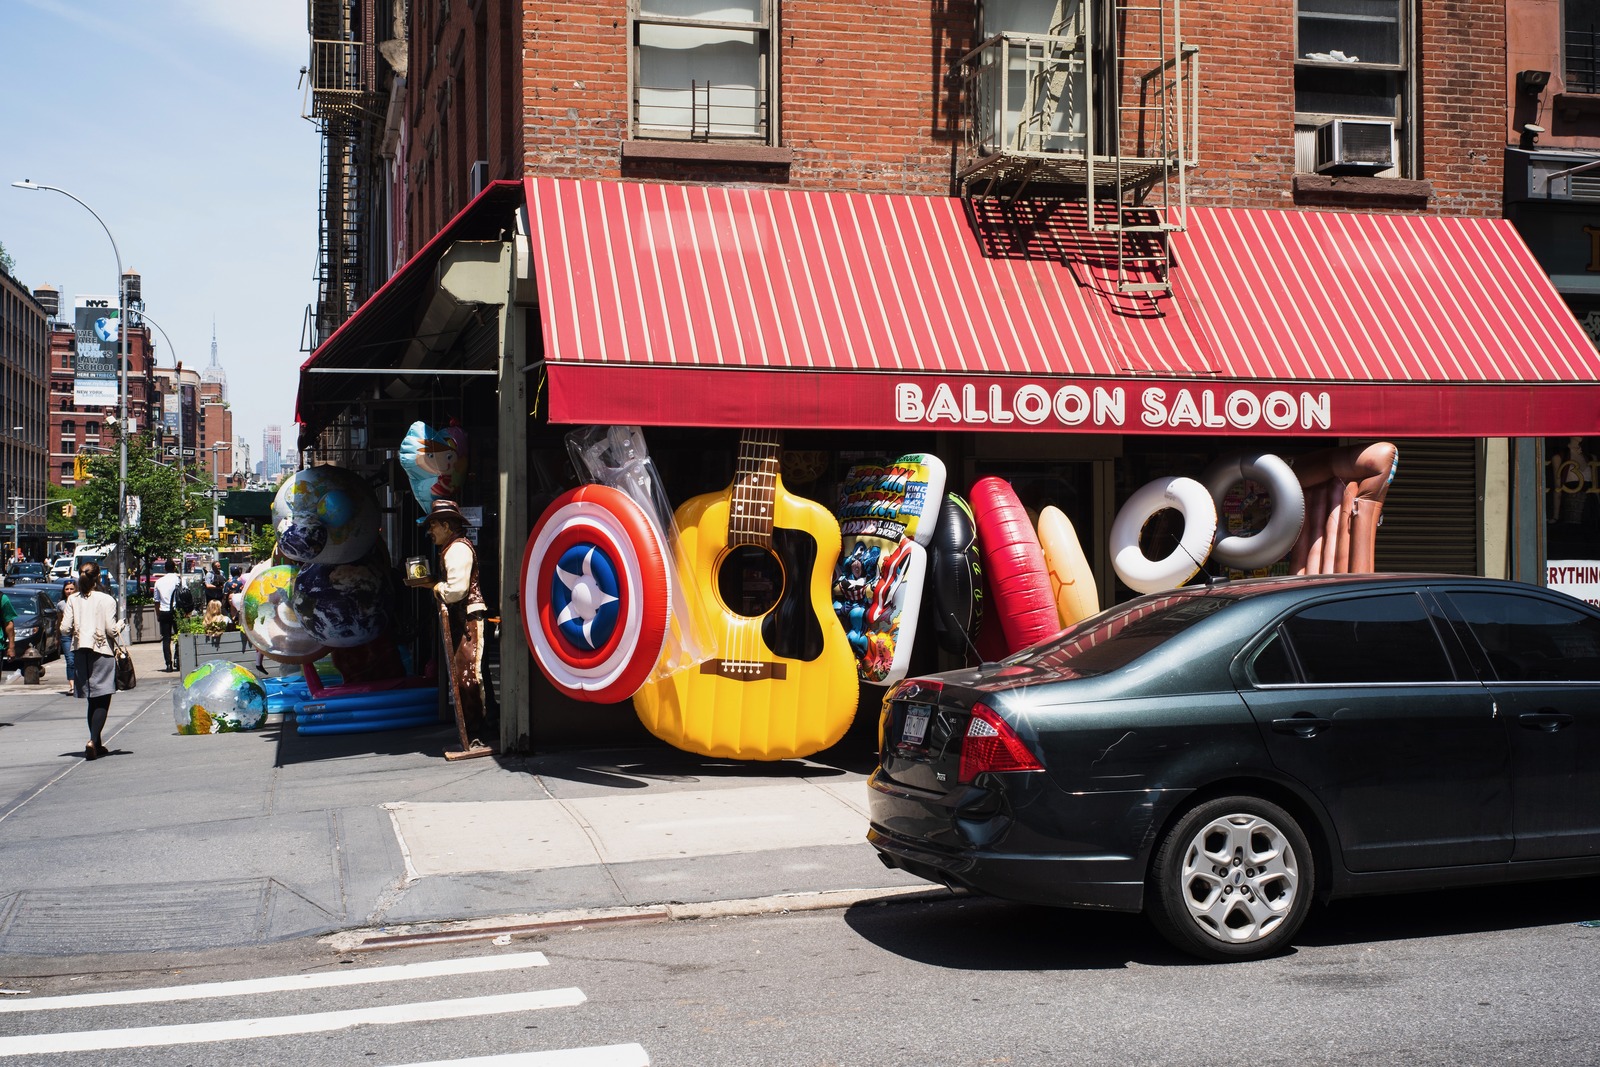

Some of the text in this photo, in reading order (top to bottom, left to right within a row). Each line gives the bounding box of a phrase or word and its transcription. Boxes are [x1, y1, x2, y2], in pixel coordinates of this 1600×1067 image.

[895, 382, 1332, 430] BALLOON SALOON
[1547, 566, 1600, 584] RYTHIN
